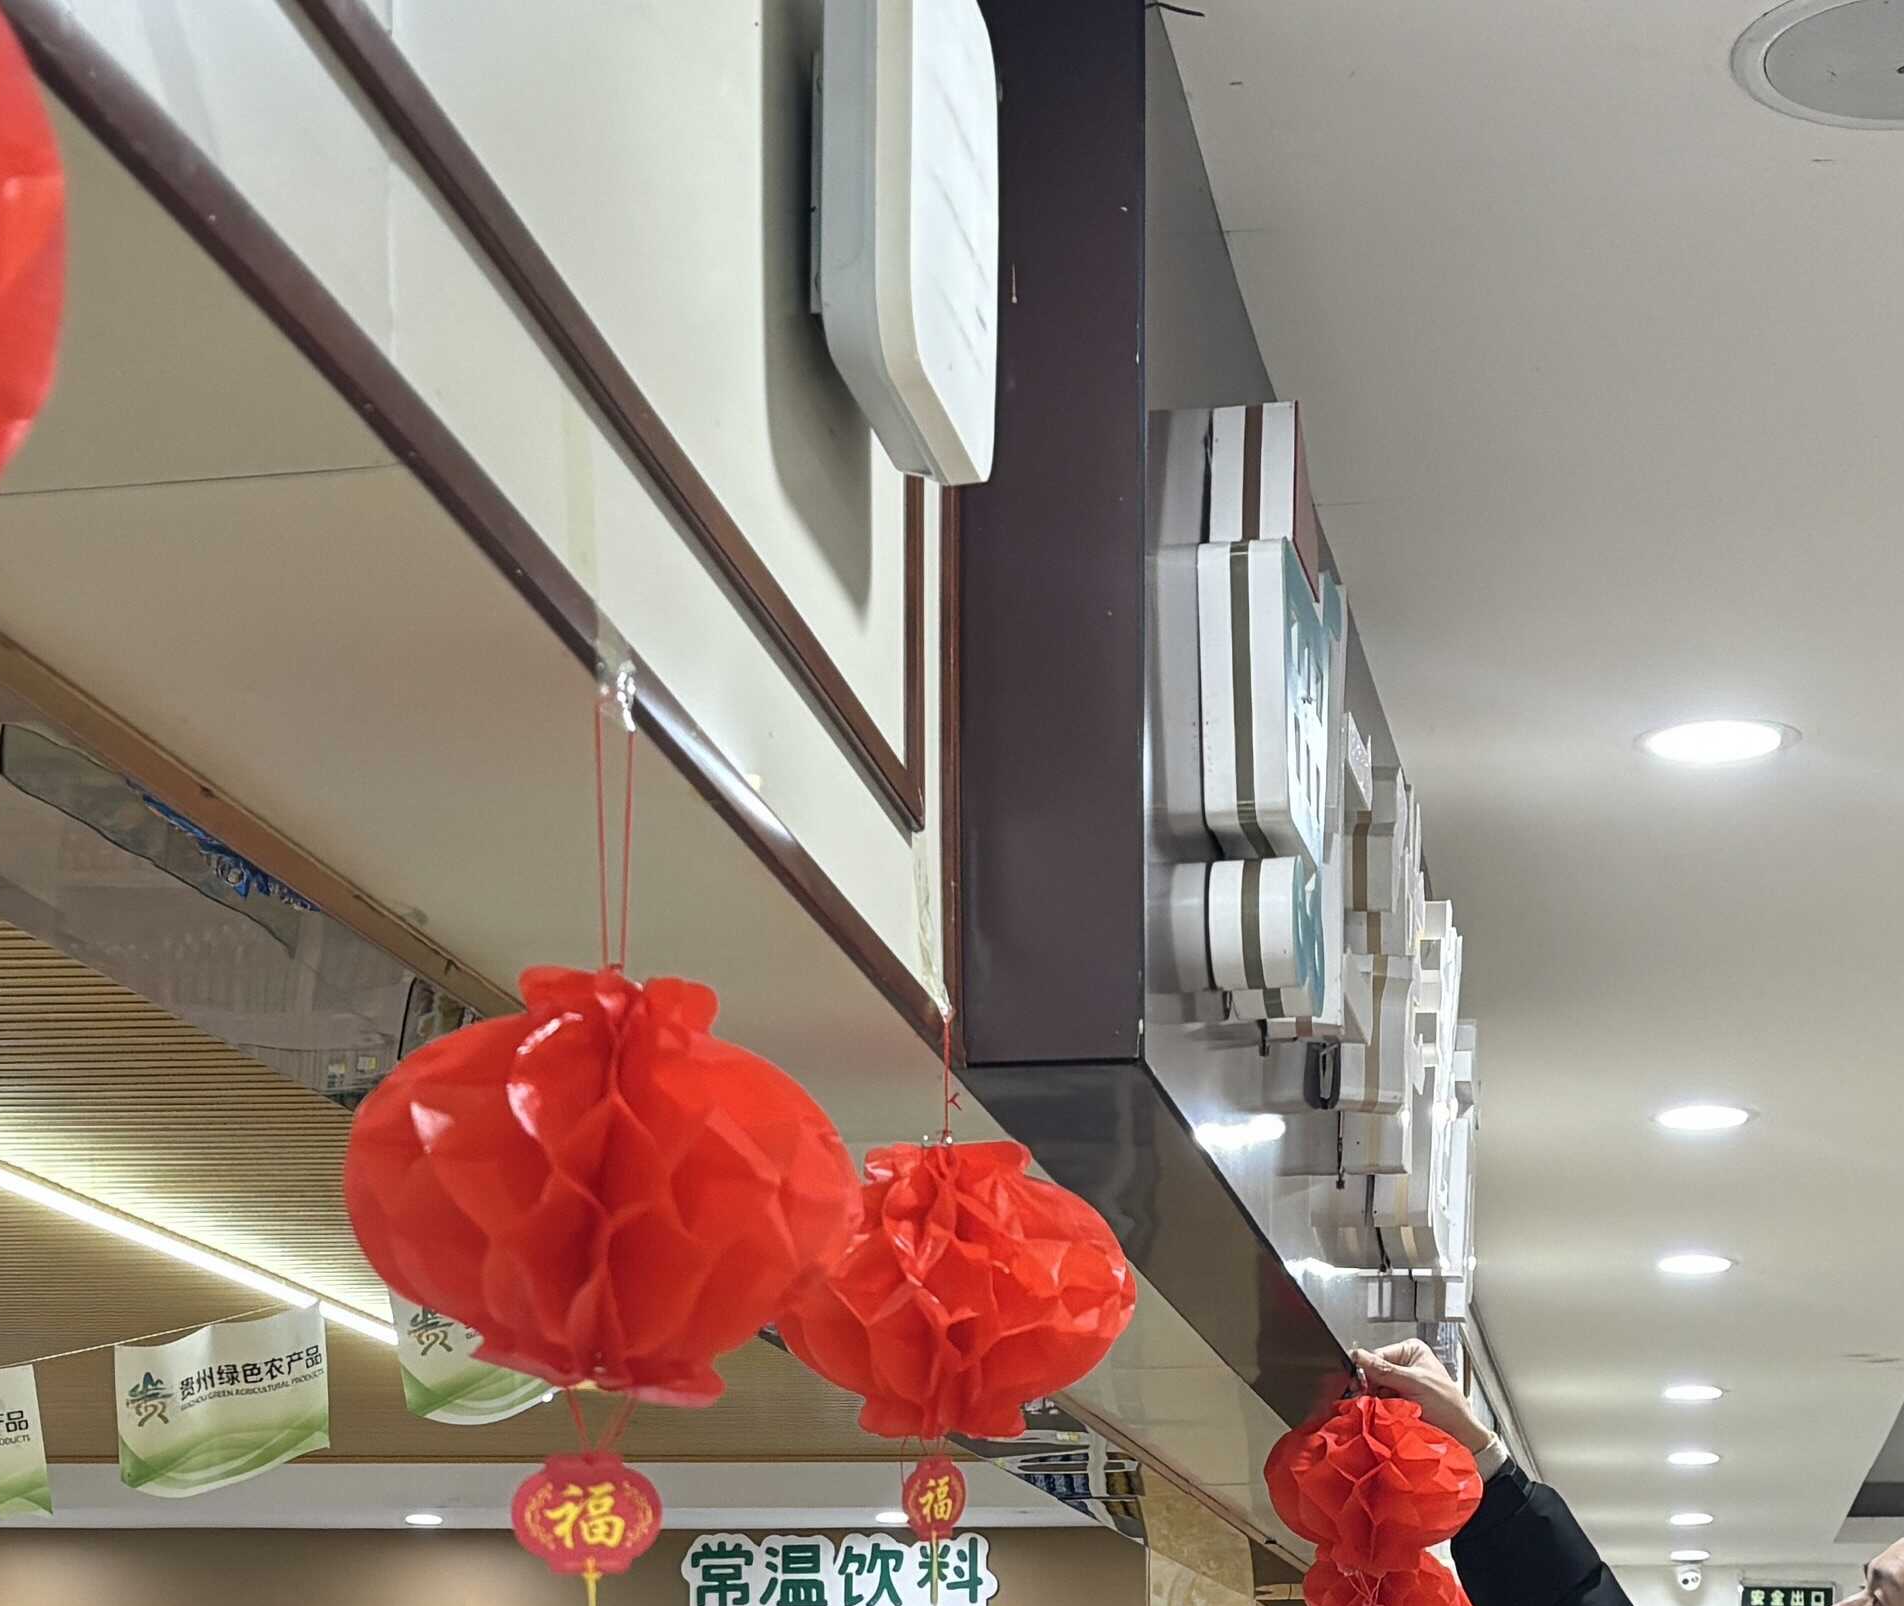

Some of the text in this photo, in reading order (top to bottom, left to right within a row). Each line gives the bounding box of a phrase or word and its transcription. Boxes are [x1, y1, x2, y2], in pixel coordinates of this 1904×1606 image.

[180, 1345, 322, 1401] 贵州绿色农产品
[545, 1482, 625, 1548] 福
[920, 1479, 953, 1522] 福
[1750, 1590, 1825, 1606] 安全出口
